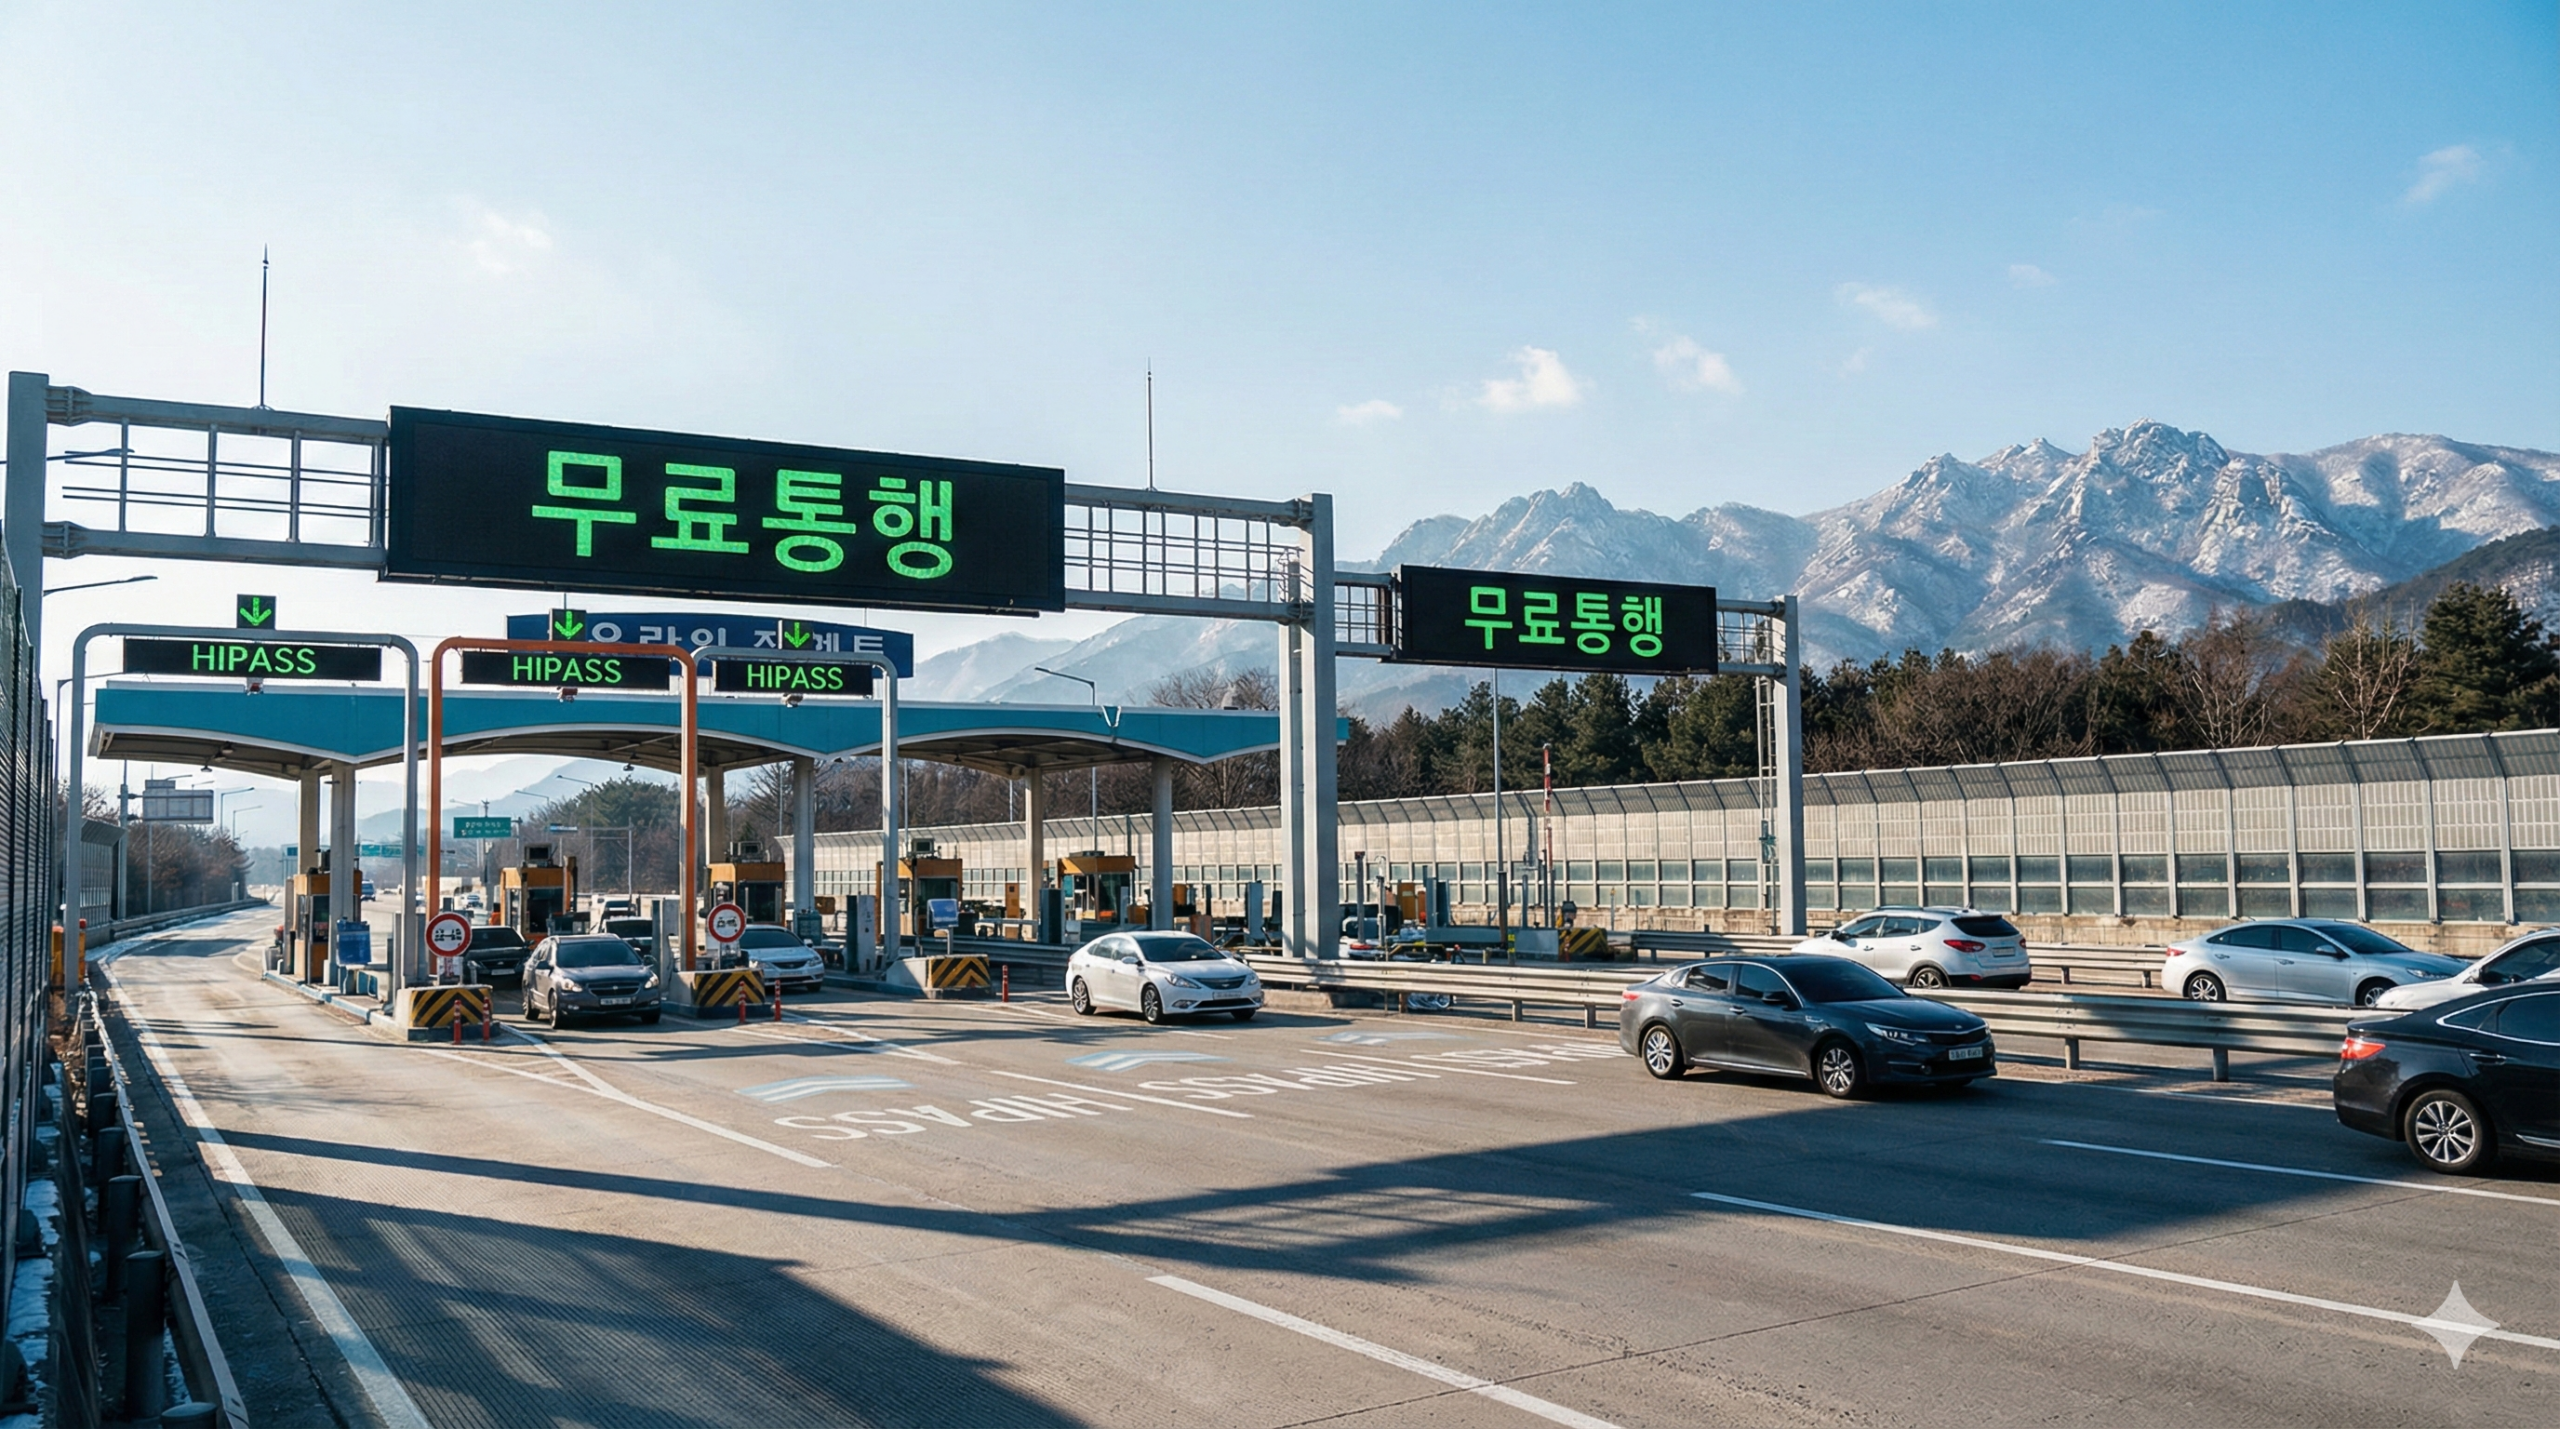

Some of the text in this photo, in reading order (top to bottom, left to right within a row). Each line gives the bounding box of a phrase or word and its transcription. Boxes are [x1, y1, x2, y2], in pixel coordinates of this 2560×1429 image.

[532, 451, 952, 579] 무료통행
[1465, 587, 1662, 657] 무료통행
[193, 645, 316, 674] HIPASS
[513, 656, 622, 684] HIPASS
[747, 664, 843, 690] HIPASS
[775, 1093, 1133, 1140] HIPASS
